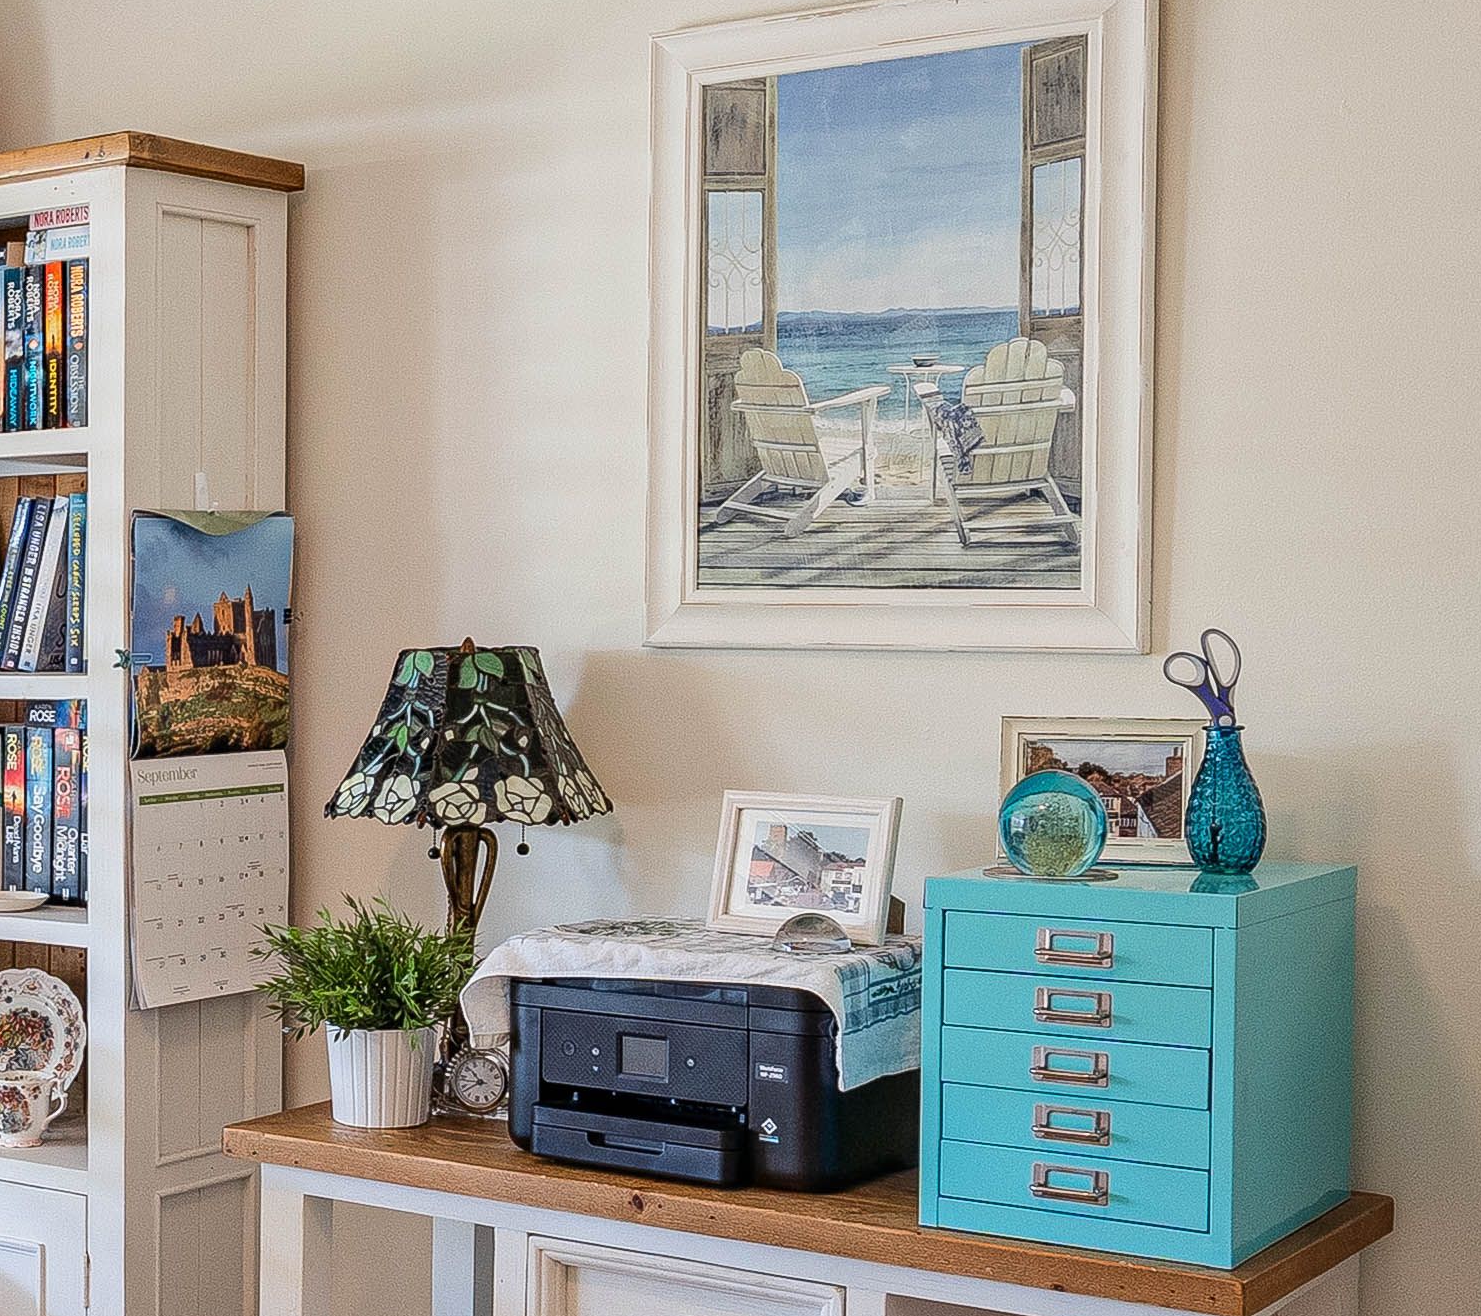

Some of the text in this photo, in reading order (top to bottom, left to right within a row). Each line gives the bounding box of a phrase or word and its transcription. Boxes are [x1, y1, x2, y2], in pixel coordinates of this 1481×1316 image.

[33, 206, 89, 228] NORA ROBERTS
[70, 265, 84, 338] NORA ROBERTS
[9, 369, 18, 426] HIDEAWAY
[48, 358, 57, 415] IDENTITY
[29, 710, 56, 722] ROSE
[138, 766, 198, 785] September
[30, 813, 46, 873] Goodbye
